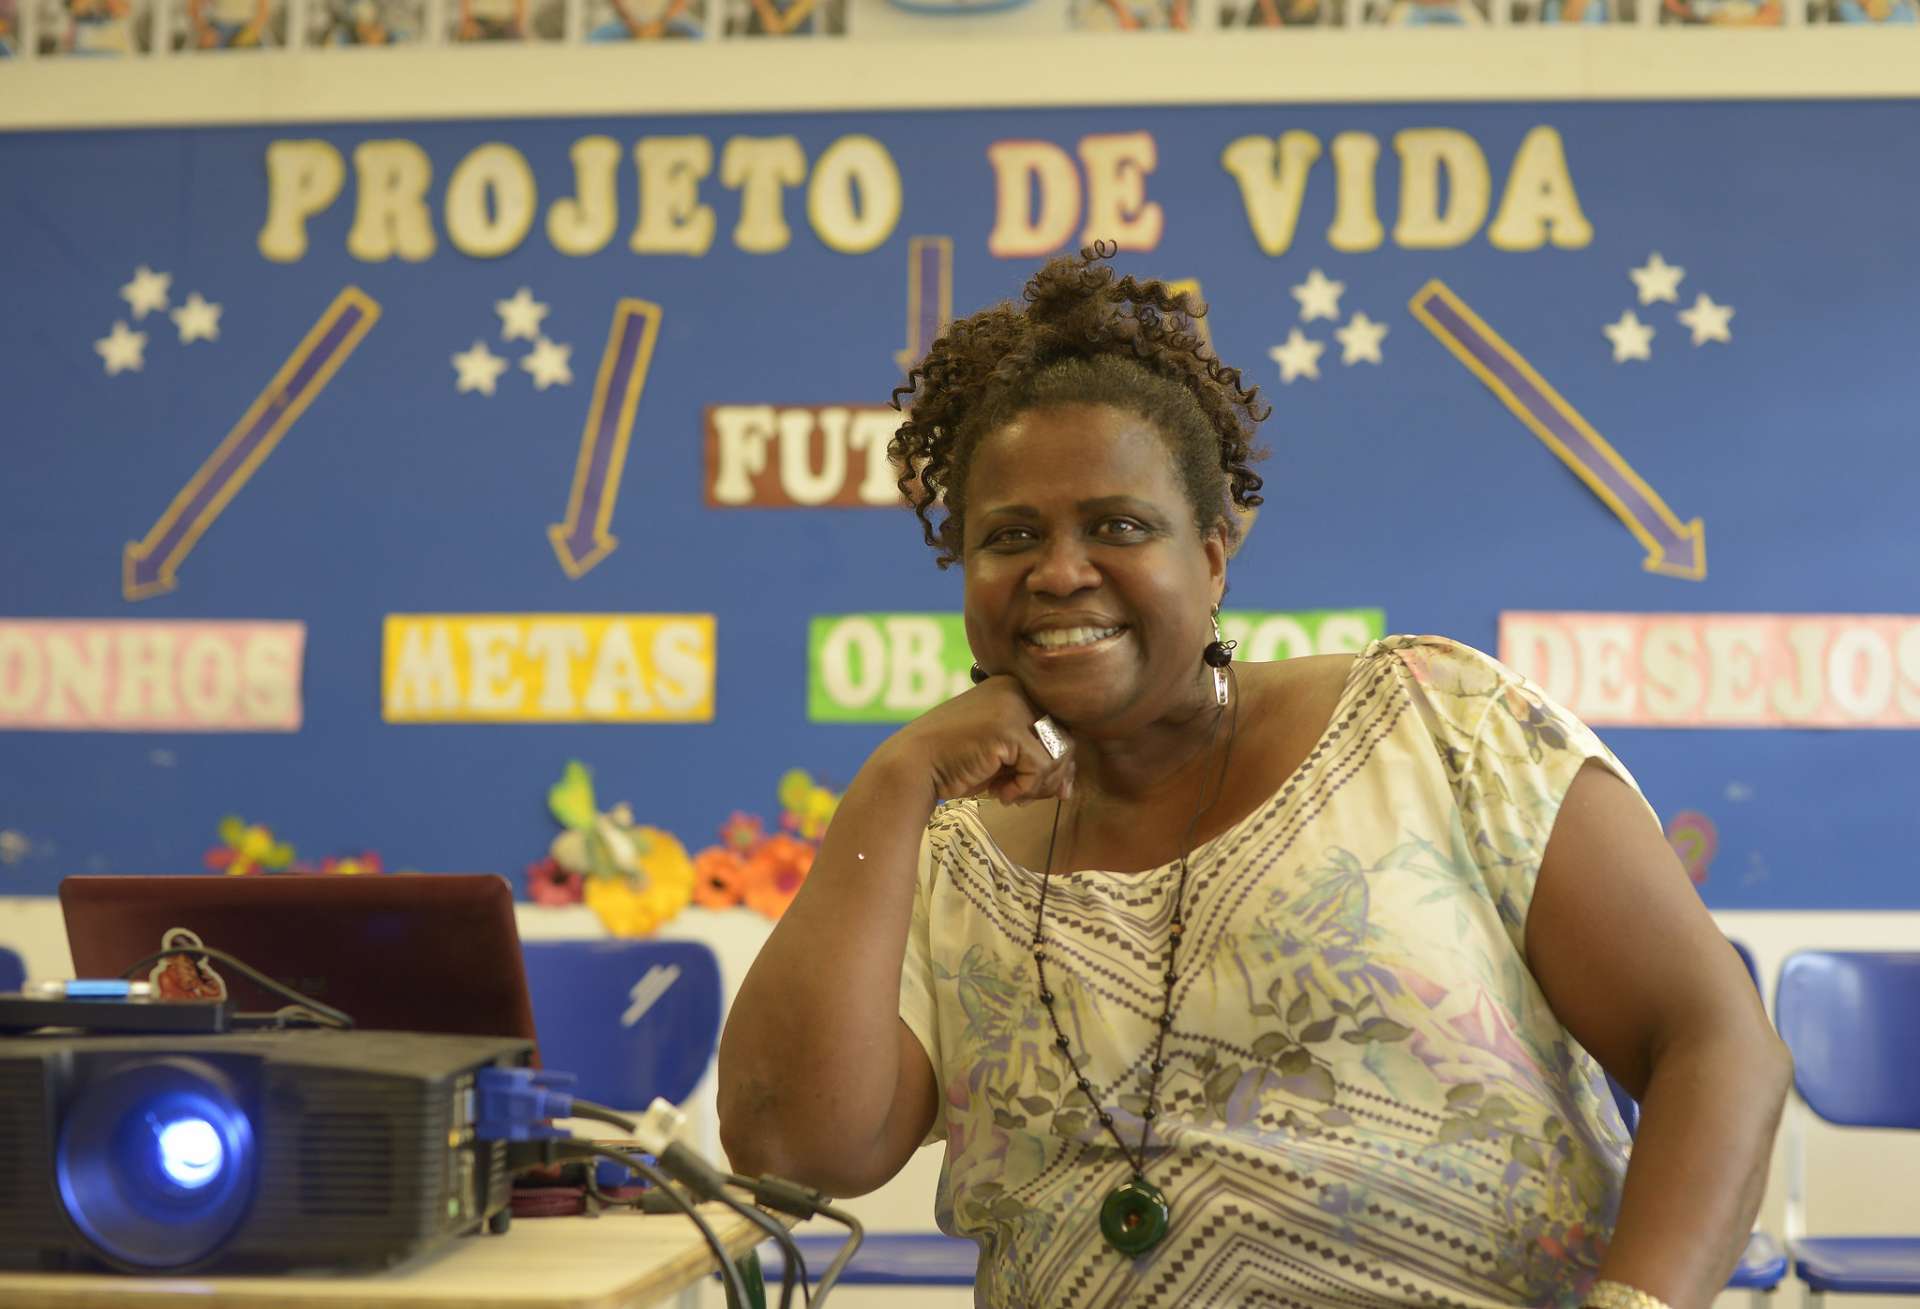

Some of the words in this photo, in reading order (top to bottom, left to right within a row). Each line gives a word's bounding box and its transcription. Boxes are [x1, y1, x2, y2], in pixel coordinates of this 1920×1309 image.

[259, 136, 902, 262] PROJETO
[986, 131, 1165, 258] DE
[1221, 126, 1594, 256] VIDA
[713, 404, 930, 506] FUT
[389, 616, 711, 712] METAS
